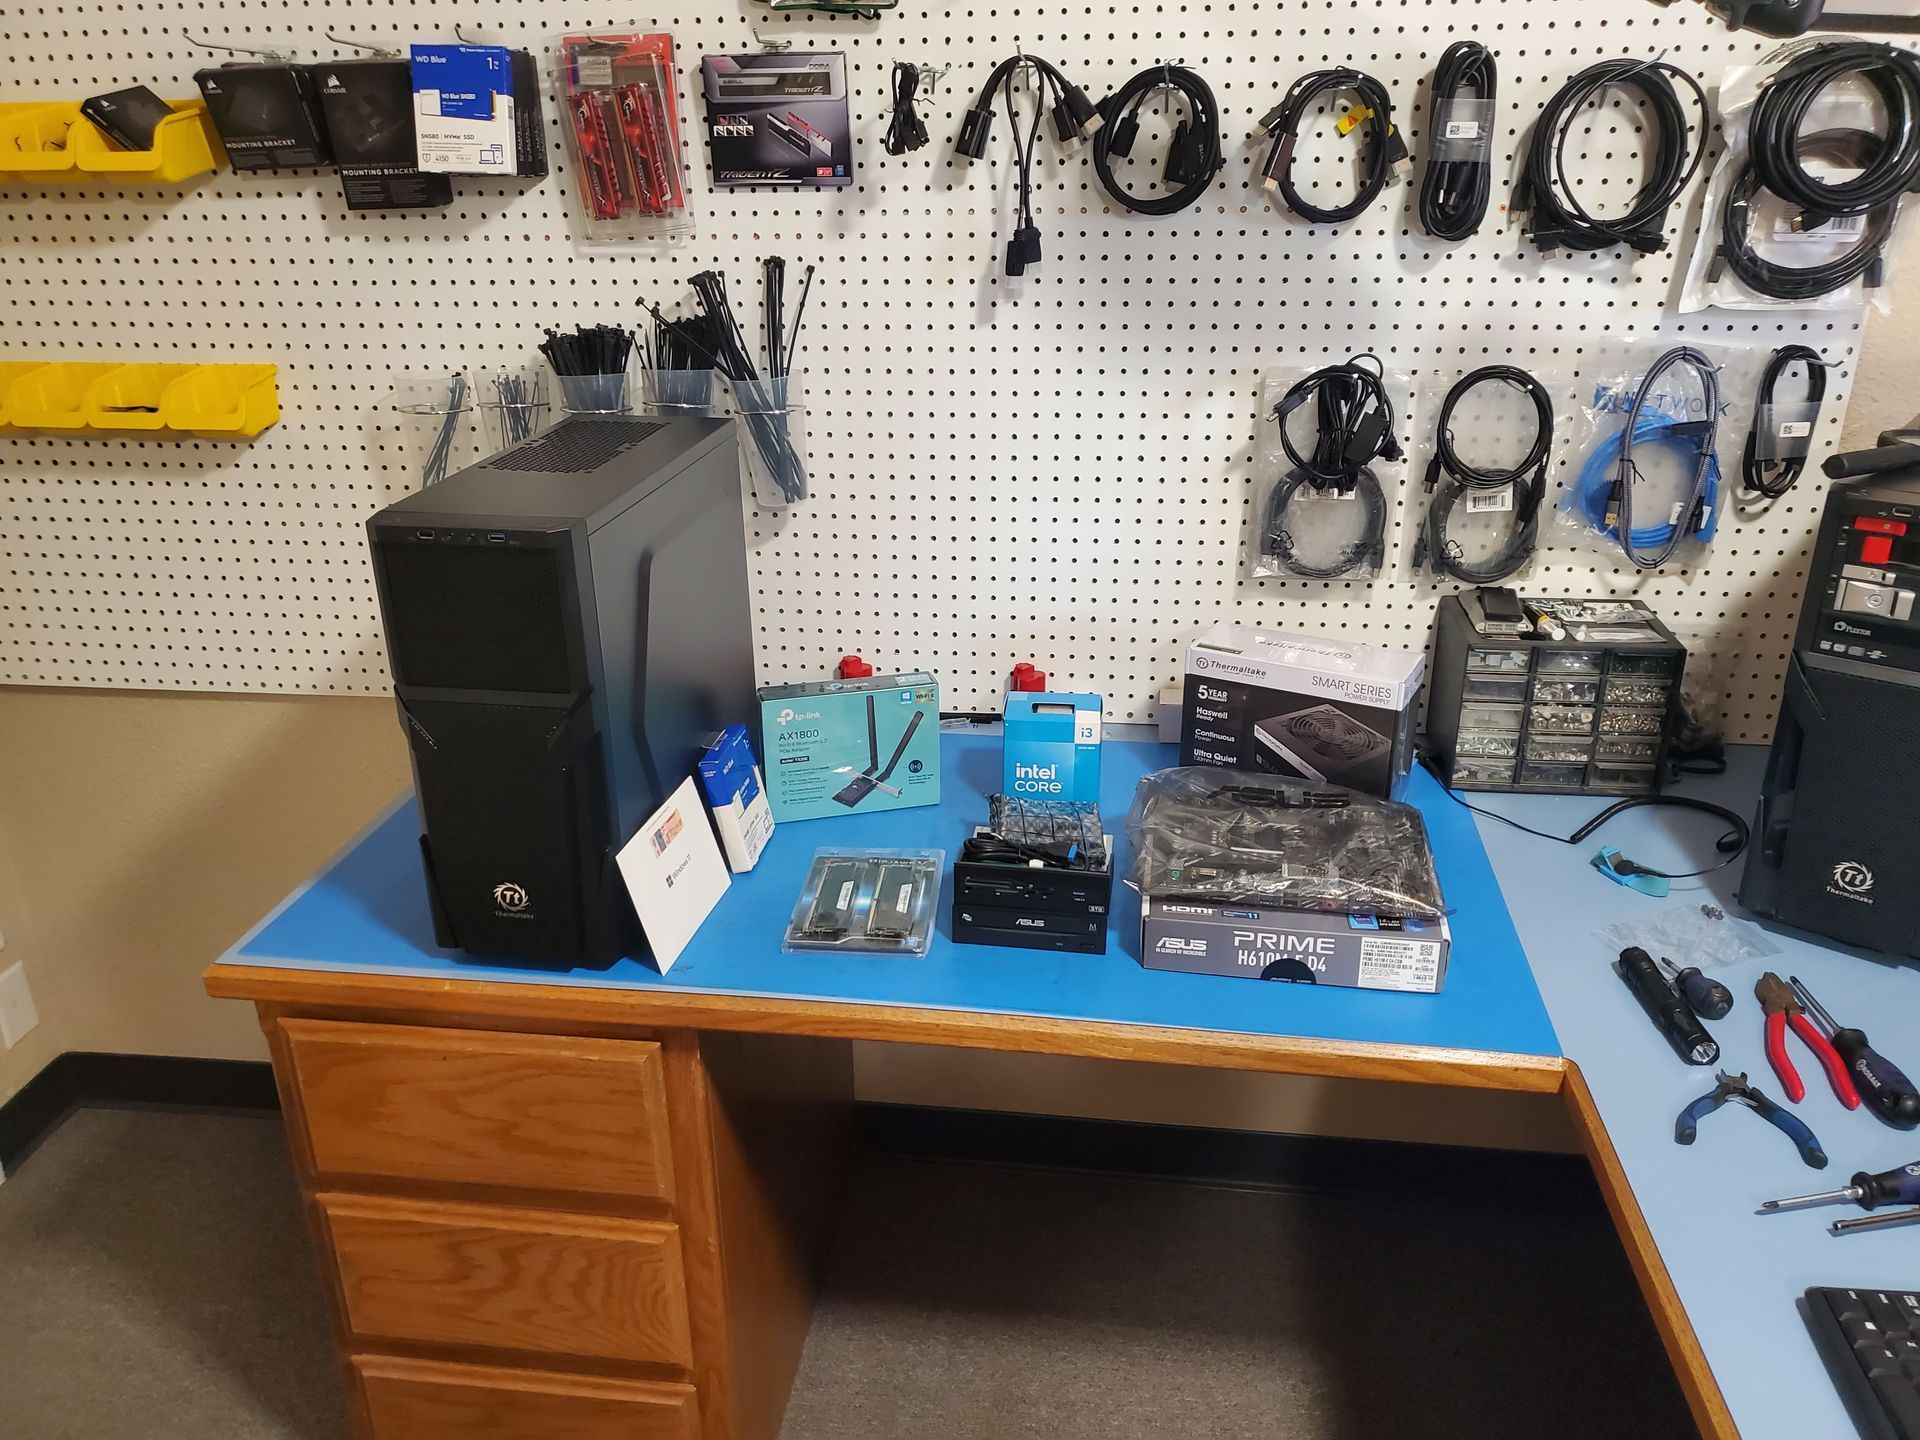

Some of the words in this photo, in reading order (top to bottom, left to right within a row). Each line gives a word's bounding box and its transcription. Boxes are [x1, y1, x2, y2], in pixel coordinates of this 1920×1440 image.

[415, 55, 429, 63] WD
[486, 57, 493, 70] 1
[226, 140, 262, 149] MOUNTING
[263, 138, 296, 148] BRACKET
[342, 168, 382, 176] MOUNTING
[1623, 390, 1732, 416] NTWOK
[1210, 660, 1267, 676] Thermaltake
[1198, 684, 1208, 700] 5
[1208, 688, 1228, 698] YEAR
[1312, 676, 1351, 692] SMART
[1352, 682, 1392, 699] SERIES
[1344, 692, 1368, 700] POWER
[1368, 696, 1390, 705] SUPPLY
[794, 711, 822, 721] tp-link
[1196, 706, 1228, 720] Haswell
[1196, 714, 1214, 722] Ready
[778, 729, 820, 742] AX1800
[1081, 728, 1093, 738] i3
[1194, 728, 1235, 742] Continuous
[1193, 748, 1212, 758] Ultra
[1214, 753, 1237, 764] Quiet
[1193, 756, 1212, 764] 120mm
[1016, 762, 1056, 780] intel
[1206, 786, 1350, 808] ASUS
[1826, 886, 1874, 904] Thermaltake
[495, 910, 535, 920] Thermaltake
[1162, 904, 1213, 914] HDMI
[1016, 918, 1044, 926] ASUS
[1156, 936, 1208, 950] ASUS
[1232, 930, 1336, 955] PRIME
[1238, 950, 1304, 967] H610
[1308, 956, 1327, 972] D4
[1862, 1066, 1882, 1088] KOBALT
